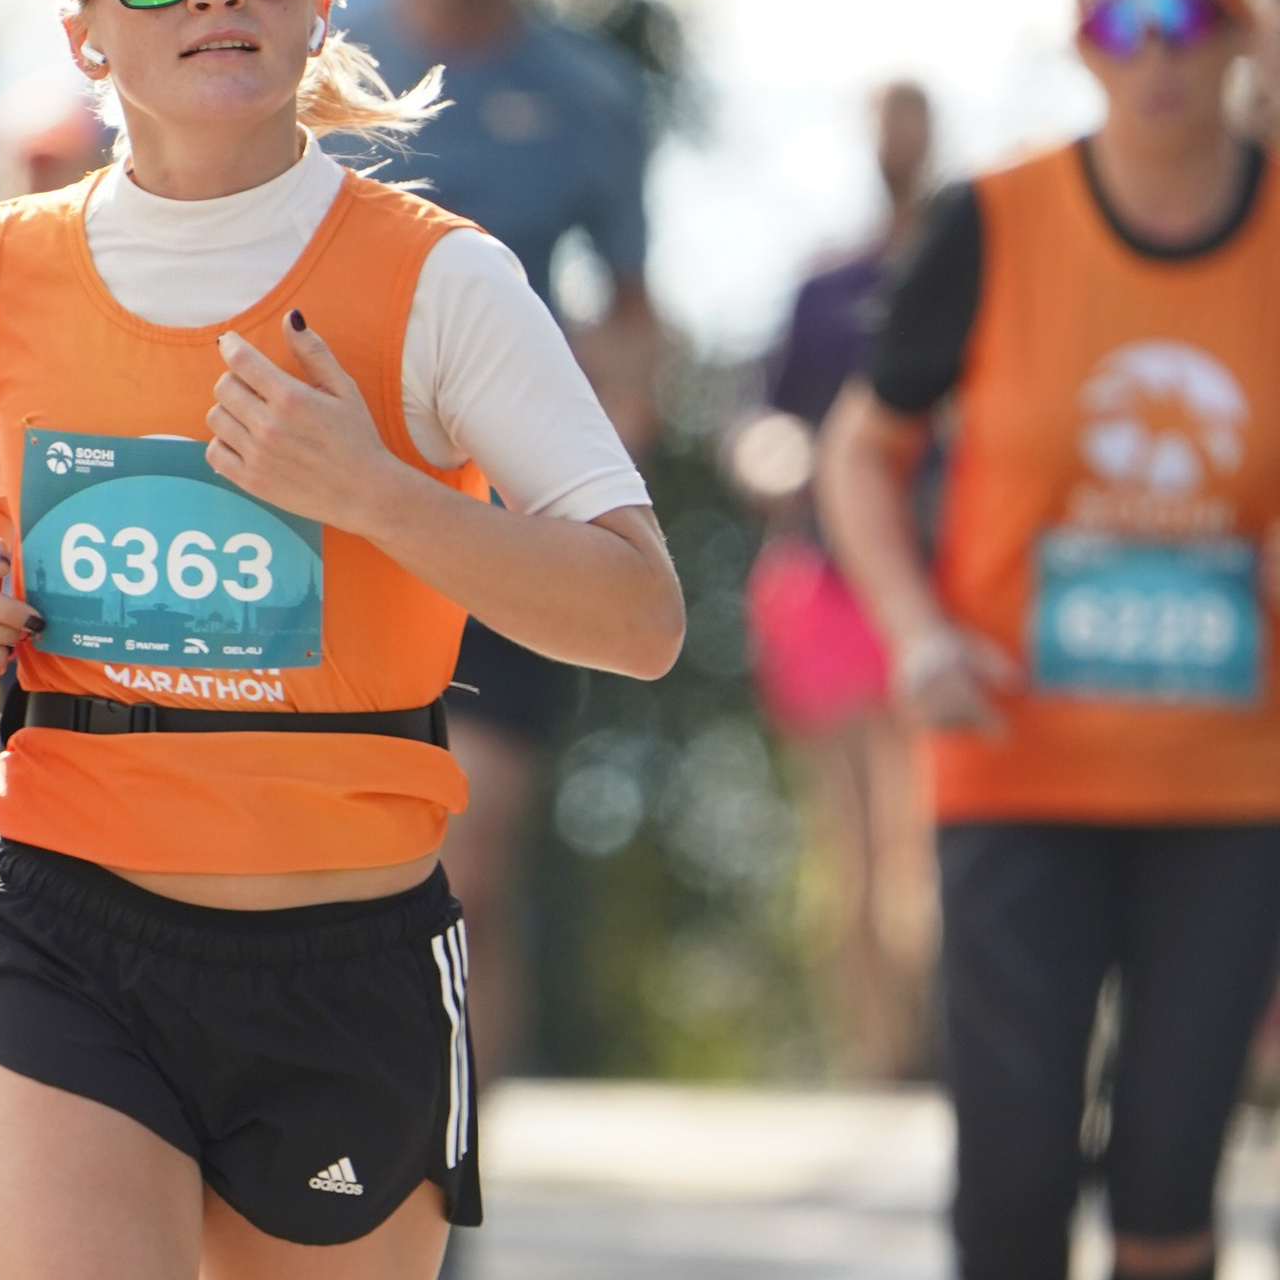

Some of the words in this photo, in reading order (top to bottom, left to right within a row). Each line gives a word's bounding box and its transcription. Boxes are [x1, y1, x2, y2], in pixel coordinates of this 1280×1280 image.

[75, 447, 115, 461] SOCHI
[60, 522, 274, 602] 6363
[104, 664, 285, 702] MARATHON
[308, 1177, 364, 1196] adidas
